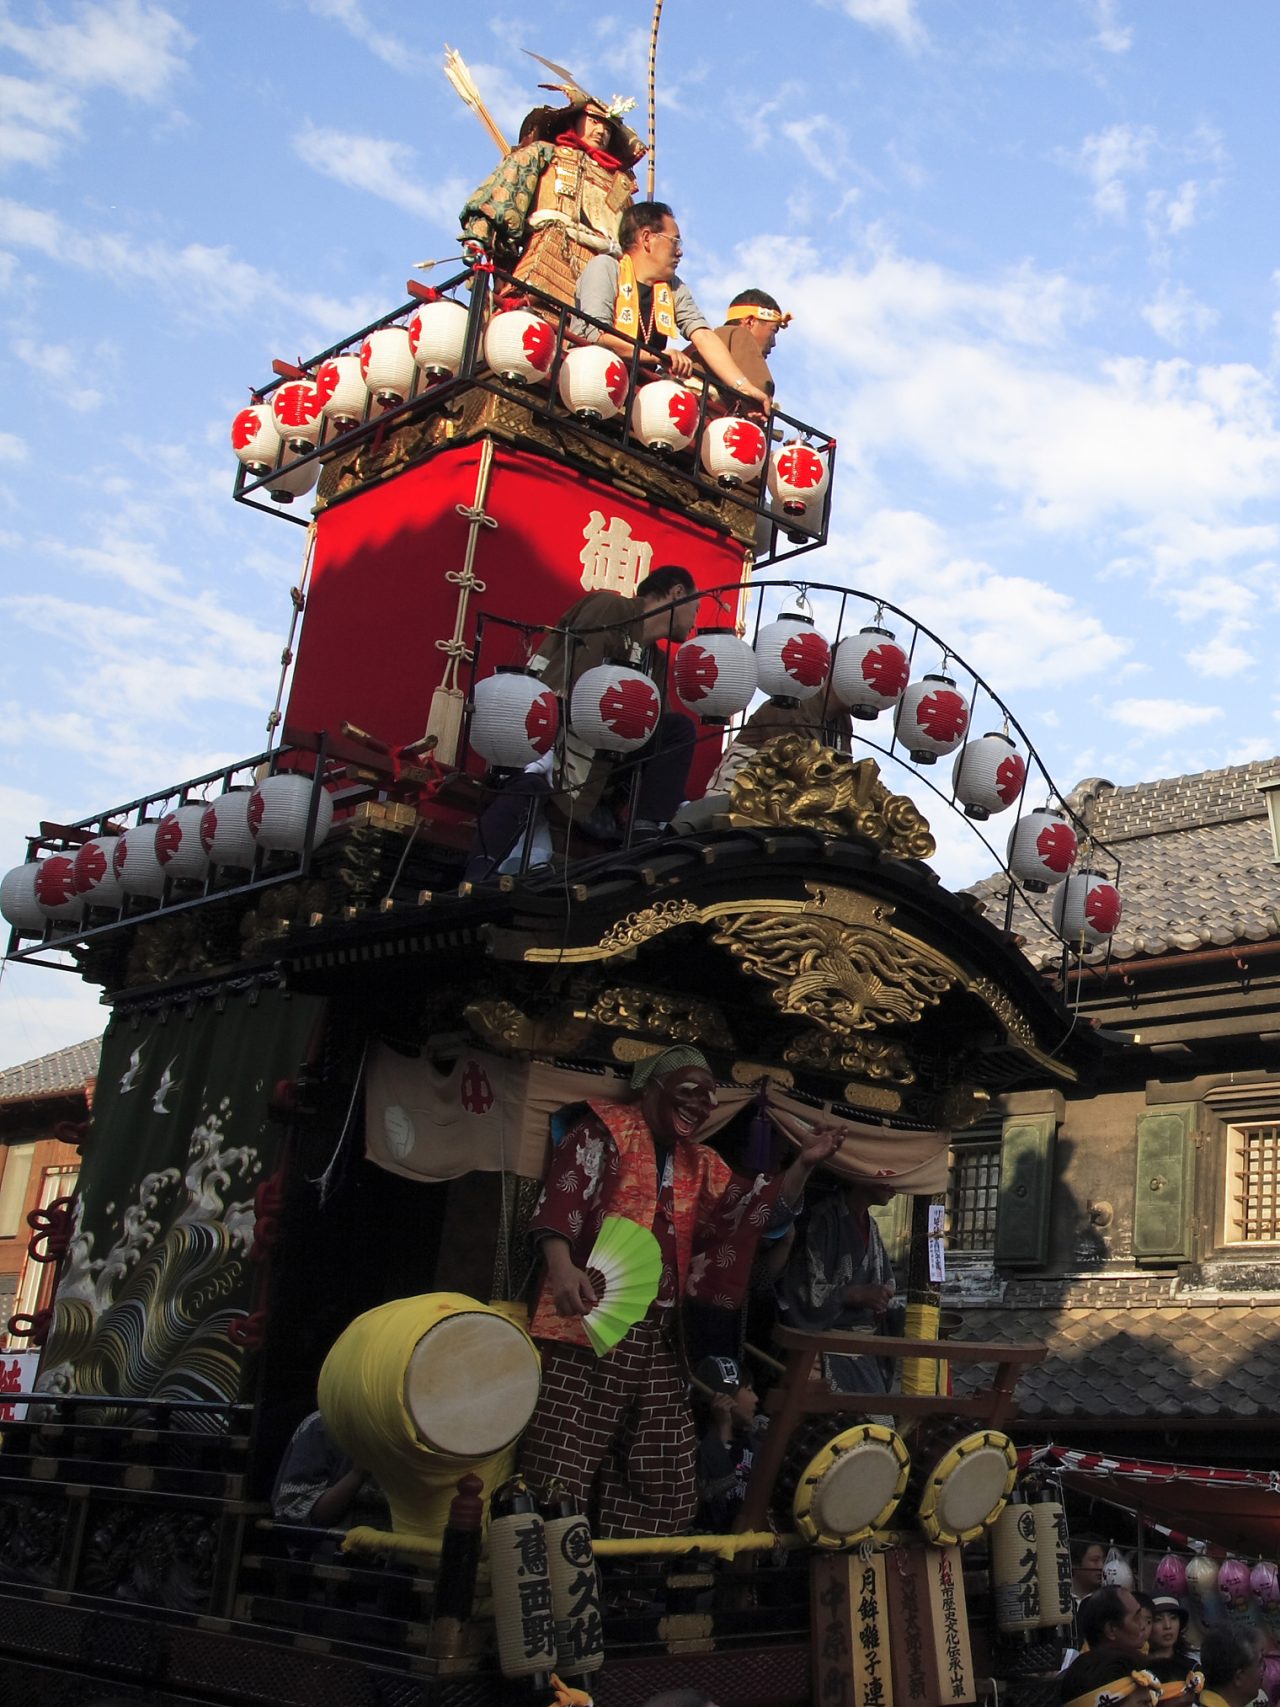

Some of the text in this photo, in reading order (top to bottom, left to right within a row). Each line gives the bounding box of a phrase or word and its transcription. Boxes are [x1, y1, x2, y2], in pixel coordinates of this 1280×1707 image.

[857, 1566, 886, 1707] 月鉾囃子連
